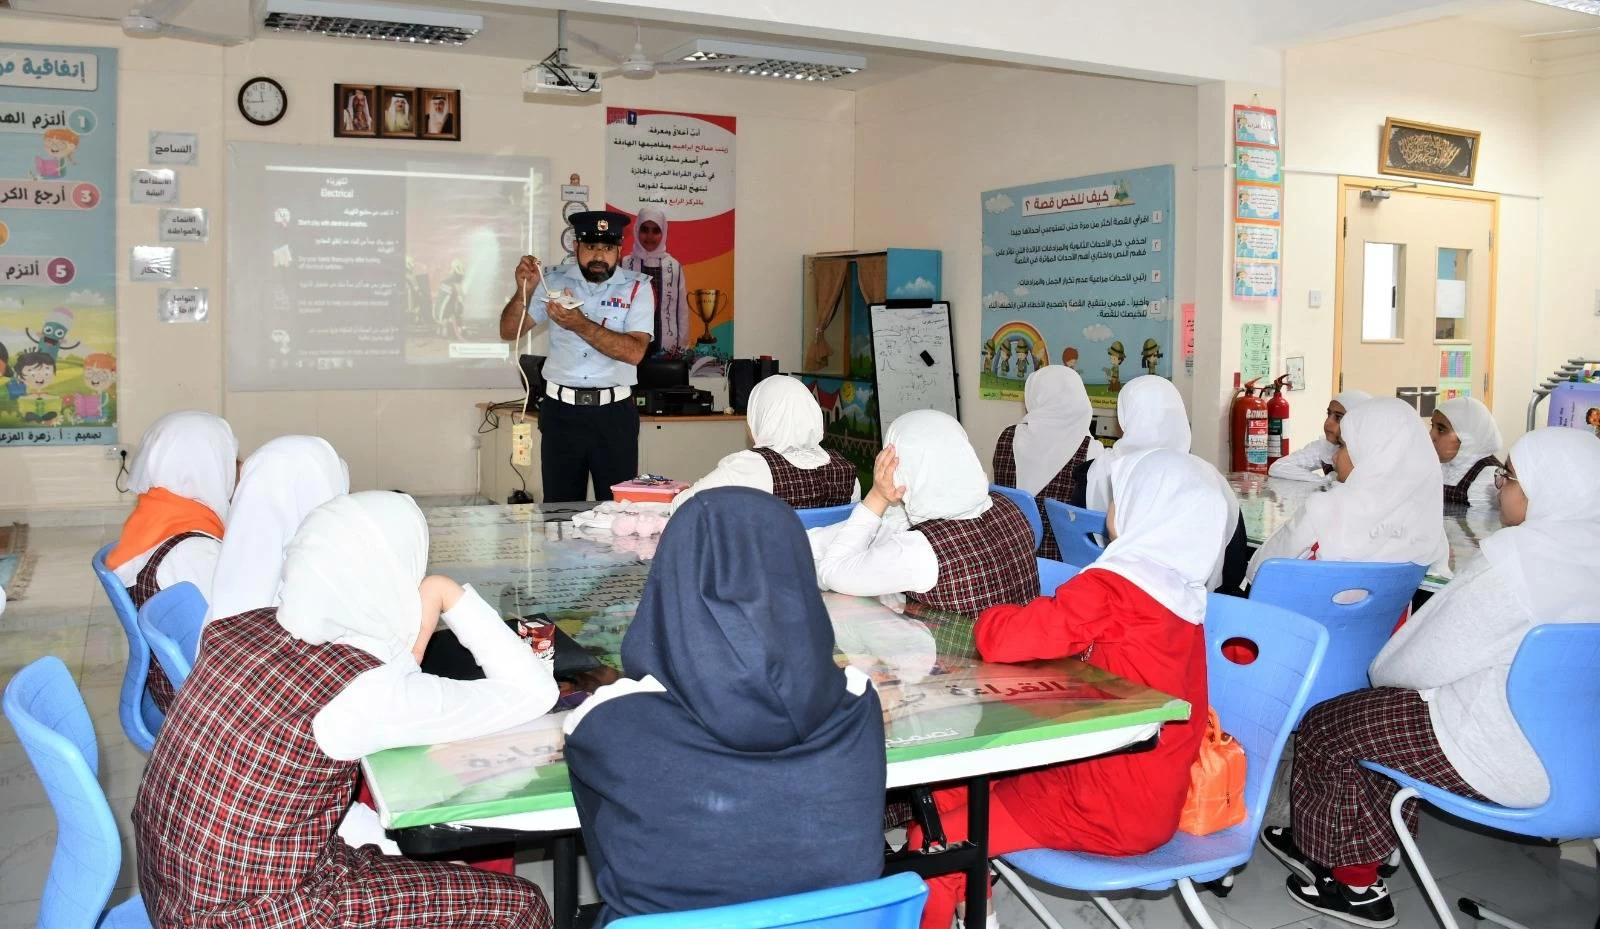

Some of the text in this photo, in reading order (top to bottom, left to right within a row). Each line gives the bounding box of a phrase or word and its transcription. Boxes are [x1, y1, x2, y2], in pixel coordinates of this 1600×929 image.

[33, 110, 65, 129] ألتزم
[34, 186, 65, 204] أرجع
[1057, 192, 1085, 209] نلخص
[1086, 190, 1109, 205] كيف
[1034, 197, 1054, 210] قصة
[6, 261, 39, 279] ألتزم
[56, 264, 66, 277] 5
[946, 681, 1067, 697] القراءة
